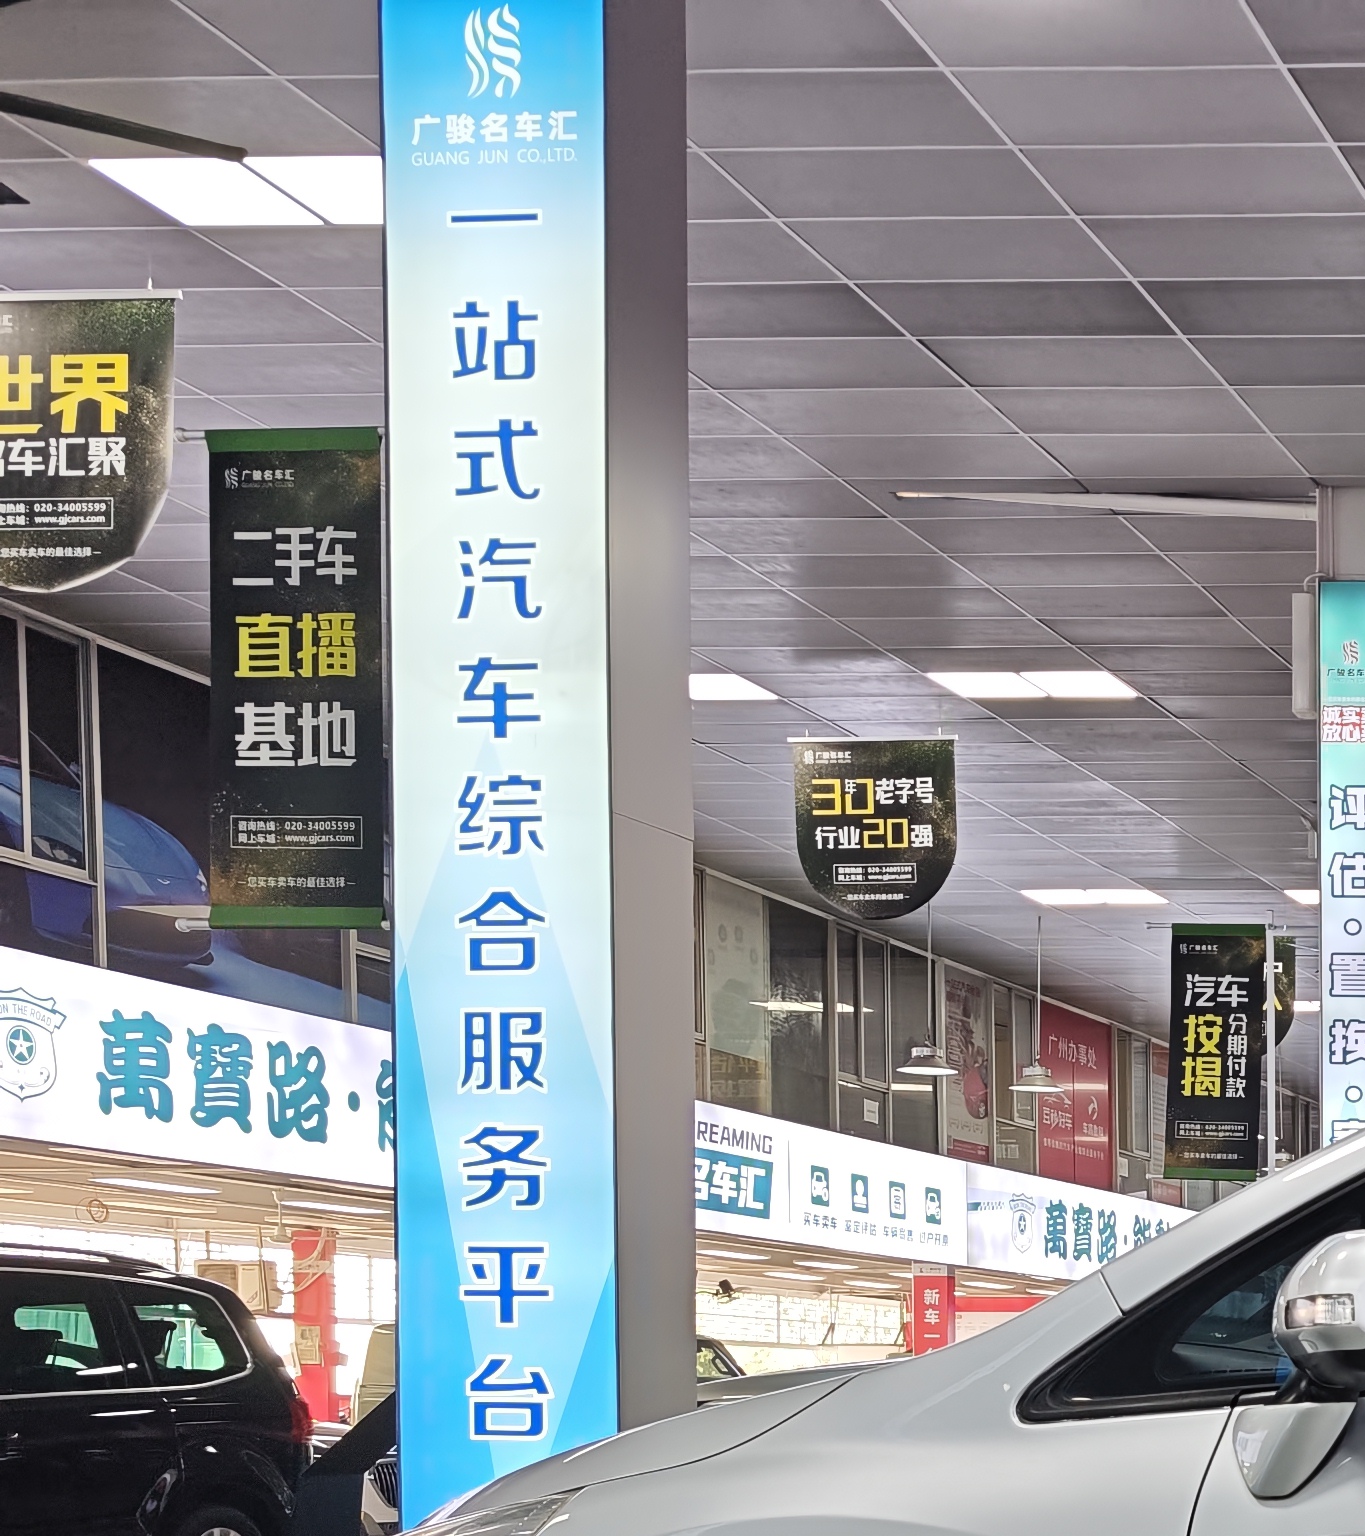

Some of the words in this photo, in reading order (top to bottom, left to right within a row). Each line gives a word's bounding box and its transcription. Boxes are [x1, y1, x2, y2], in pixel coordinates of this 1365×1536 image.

[411, 110, 578, 146] 广骏名车汇
[411, 150, 470, 167] GUANG
[477, 149, 509, 165] JUN
[0, 353, 129, 434] 世界
[0, 436, 127, 477] 车汇聚
[232, 525, 358, 586] 二手车
[234, 612, 356, 678] 直播
[234, 701, 357, 767] 基地
[449, 210, 554, 1439] 一站式汽车综合服务平台
[811, 776, 935, 816] 30年老字号
[814, 818, 934, 850] 行业20强
[12, 1003, 28, 1016] THE
[30, 1011, 52, 1027] ROAD
[1184, 973, 1250, 1008] 汽车
[96, 1009, 395, 1152] 萬寶路·
[1180, 1013, 1223, 1098] 按揭
[1225, 1013, 1248, 1099] 分期付款
[696, 1120, 773, 1155] REAMING
[695, 1157, 766, 1210] 名车汇
[1044, 1198, 1170, 1264] 萬寶路·能
[923, 1288, 941, 1353] 新车一
